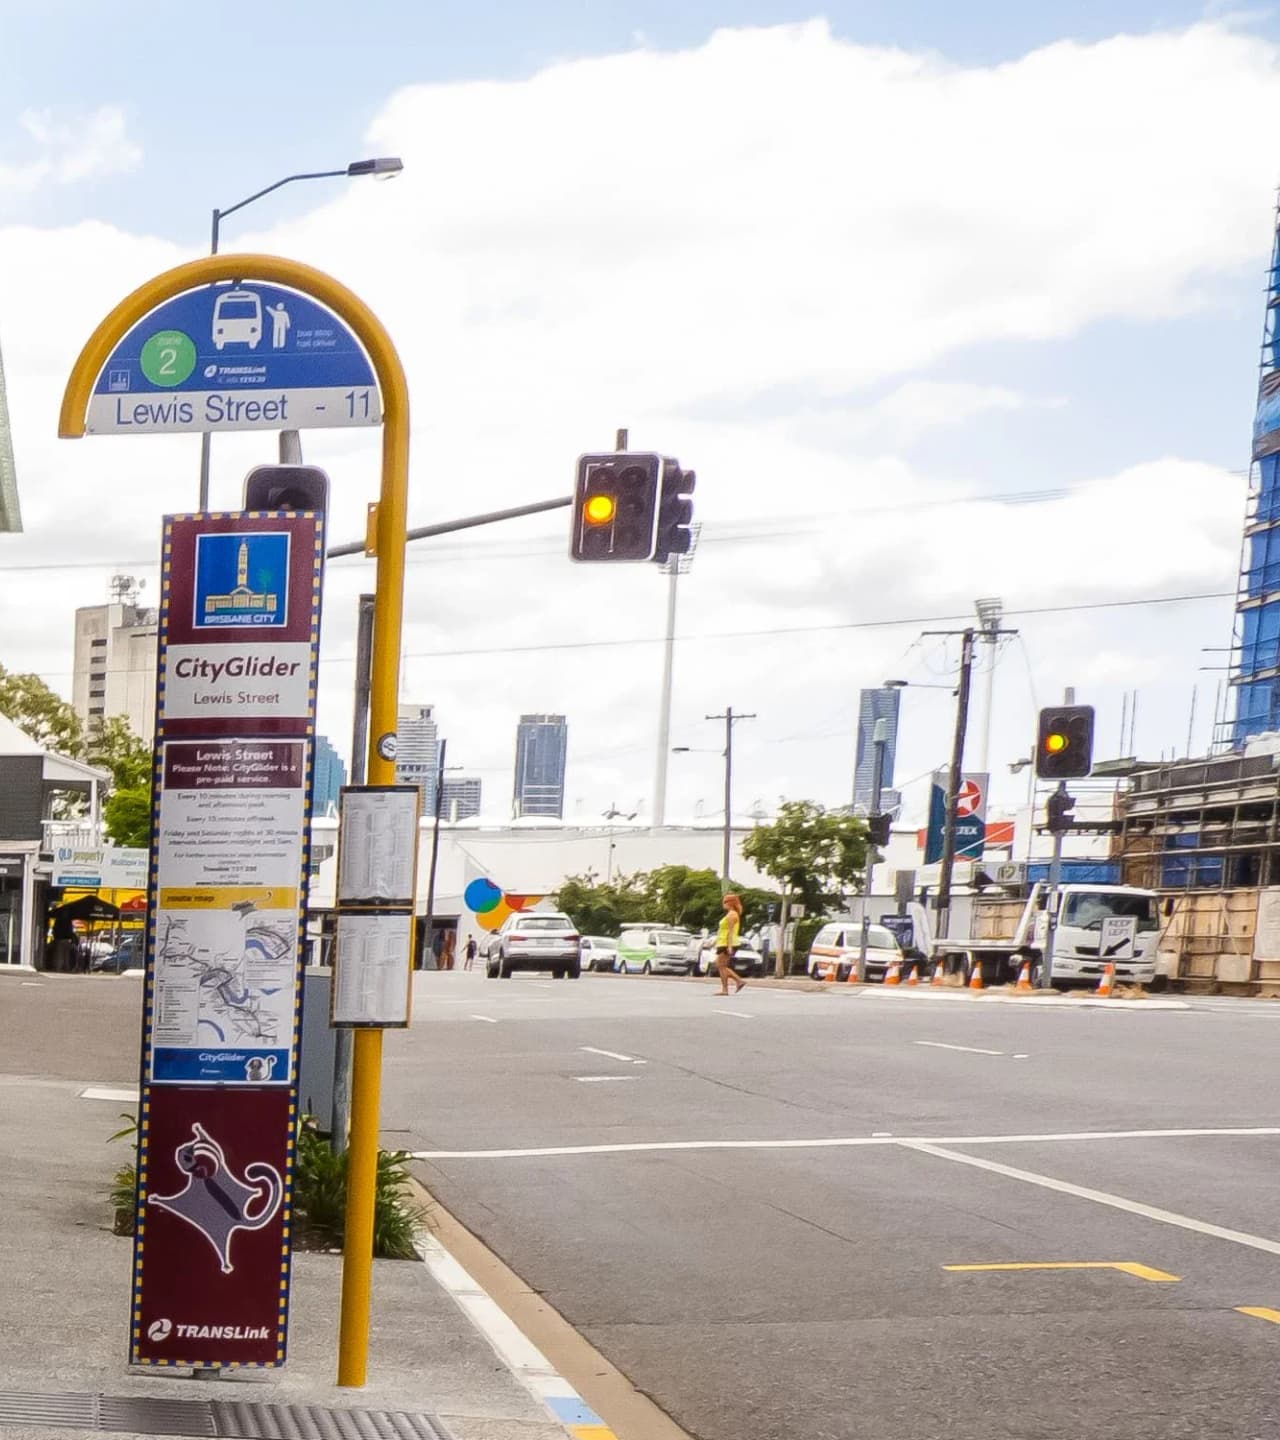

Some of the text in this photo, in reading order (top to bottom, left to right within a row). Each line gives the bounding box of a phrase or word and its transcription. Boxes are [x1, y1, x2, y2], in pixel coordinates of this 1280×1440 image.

[159, 348, 177, 375] 2
[116, 396, 194, 425] Lewis
[205, 395, 288, 422] Street
[345, 390, 370, 418] 11
[204, 613, 277, 624] BRISBANE CITY
[175, 656, 300, 683] CityGlider
[193, 690, 280, 704] Lewis Street
[196, 749, 274, 761] Lewis Street
[172, 764, 202, 773] Please
[232, 763, 279, 774] CityGlider
[940, 826, 978, 835] CTEX
[198, 1052, 246, 1063] CityGlider
[176, 1324, 270, 1340] TRANSLink
